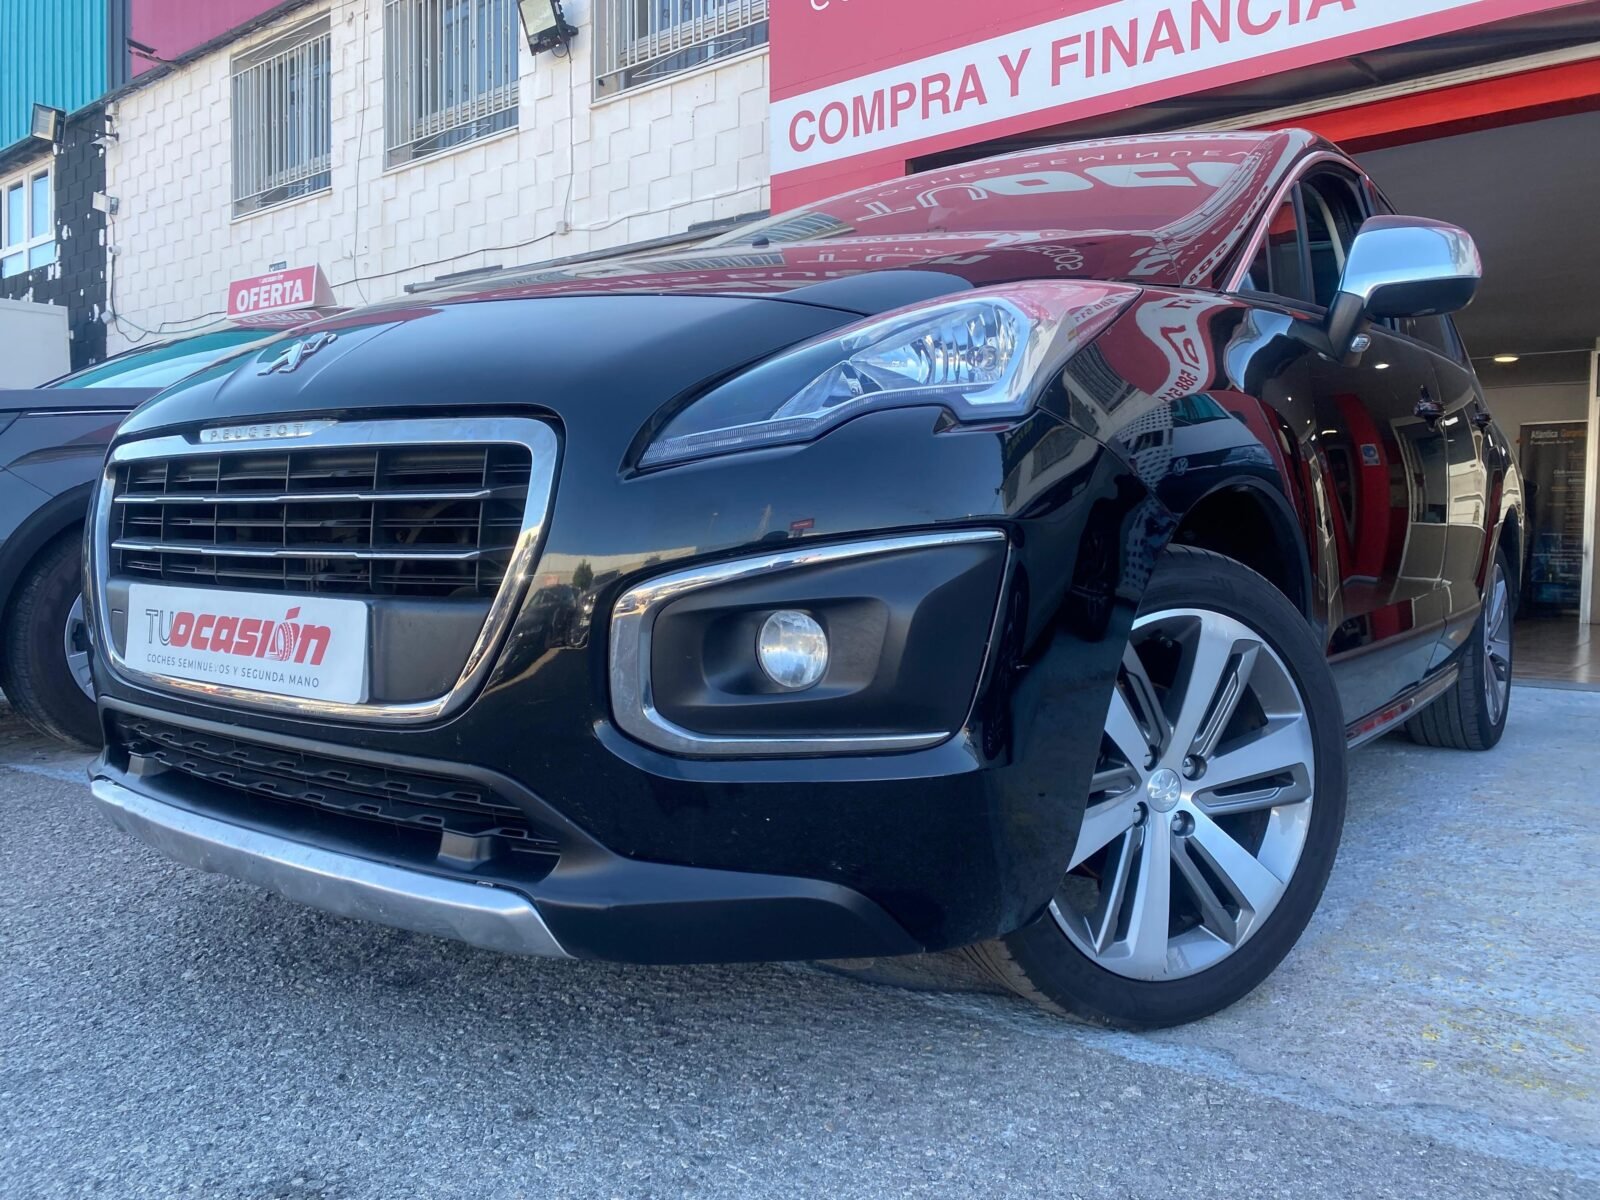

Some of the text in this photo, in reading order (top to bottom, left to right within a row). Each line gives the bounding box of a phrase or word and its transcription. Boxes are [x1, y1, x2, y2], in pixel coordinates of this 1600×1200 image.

[788, 63, 988, 152] COMPRA
[998, 47, 1032, 98] Y
[236, 278, 304, 312] OFERTA
[209, 423, 305, 442] PEUGEOT
[146, 652, 320, 688] COCHES SEMINUEVOS Y SEGUNDA MANO
